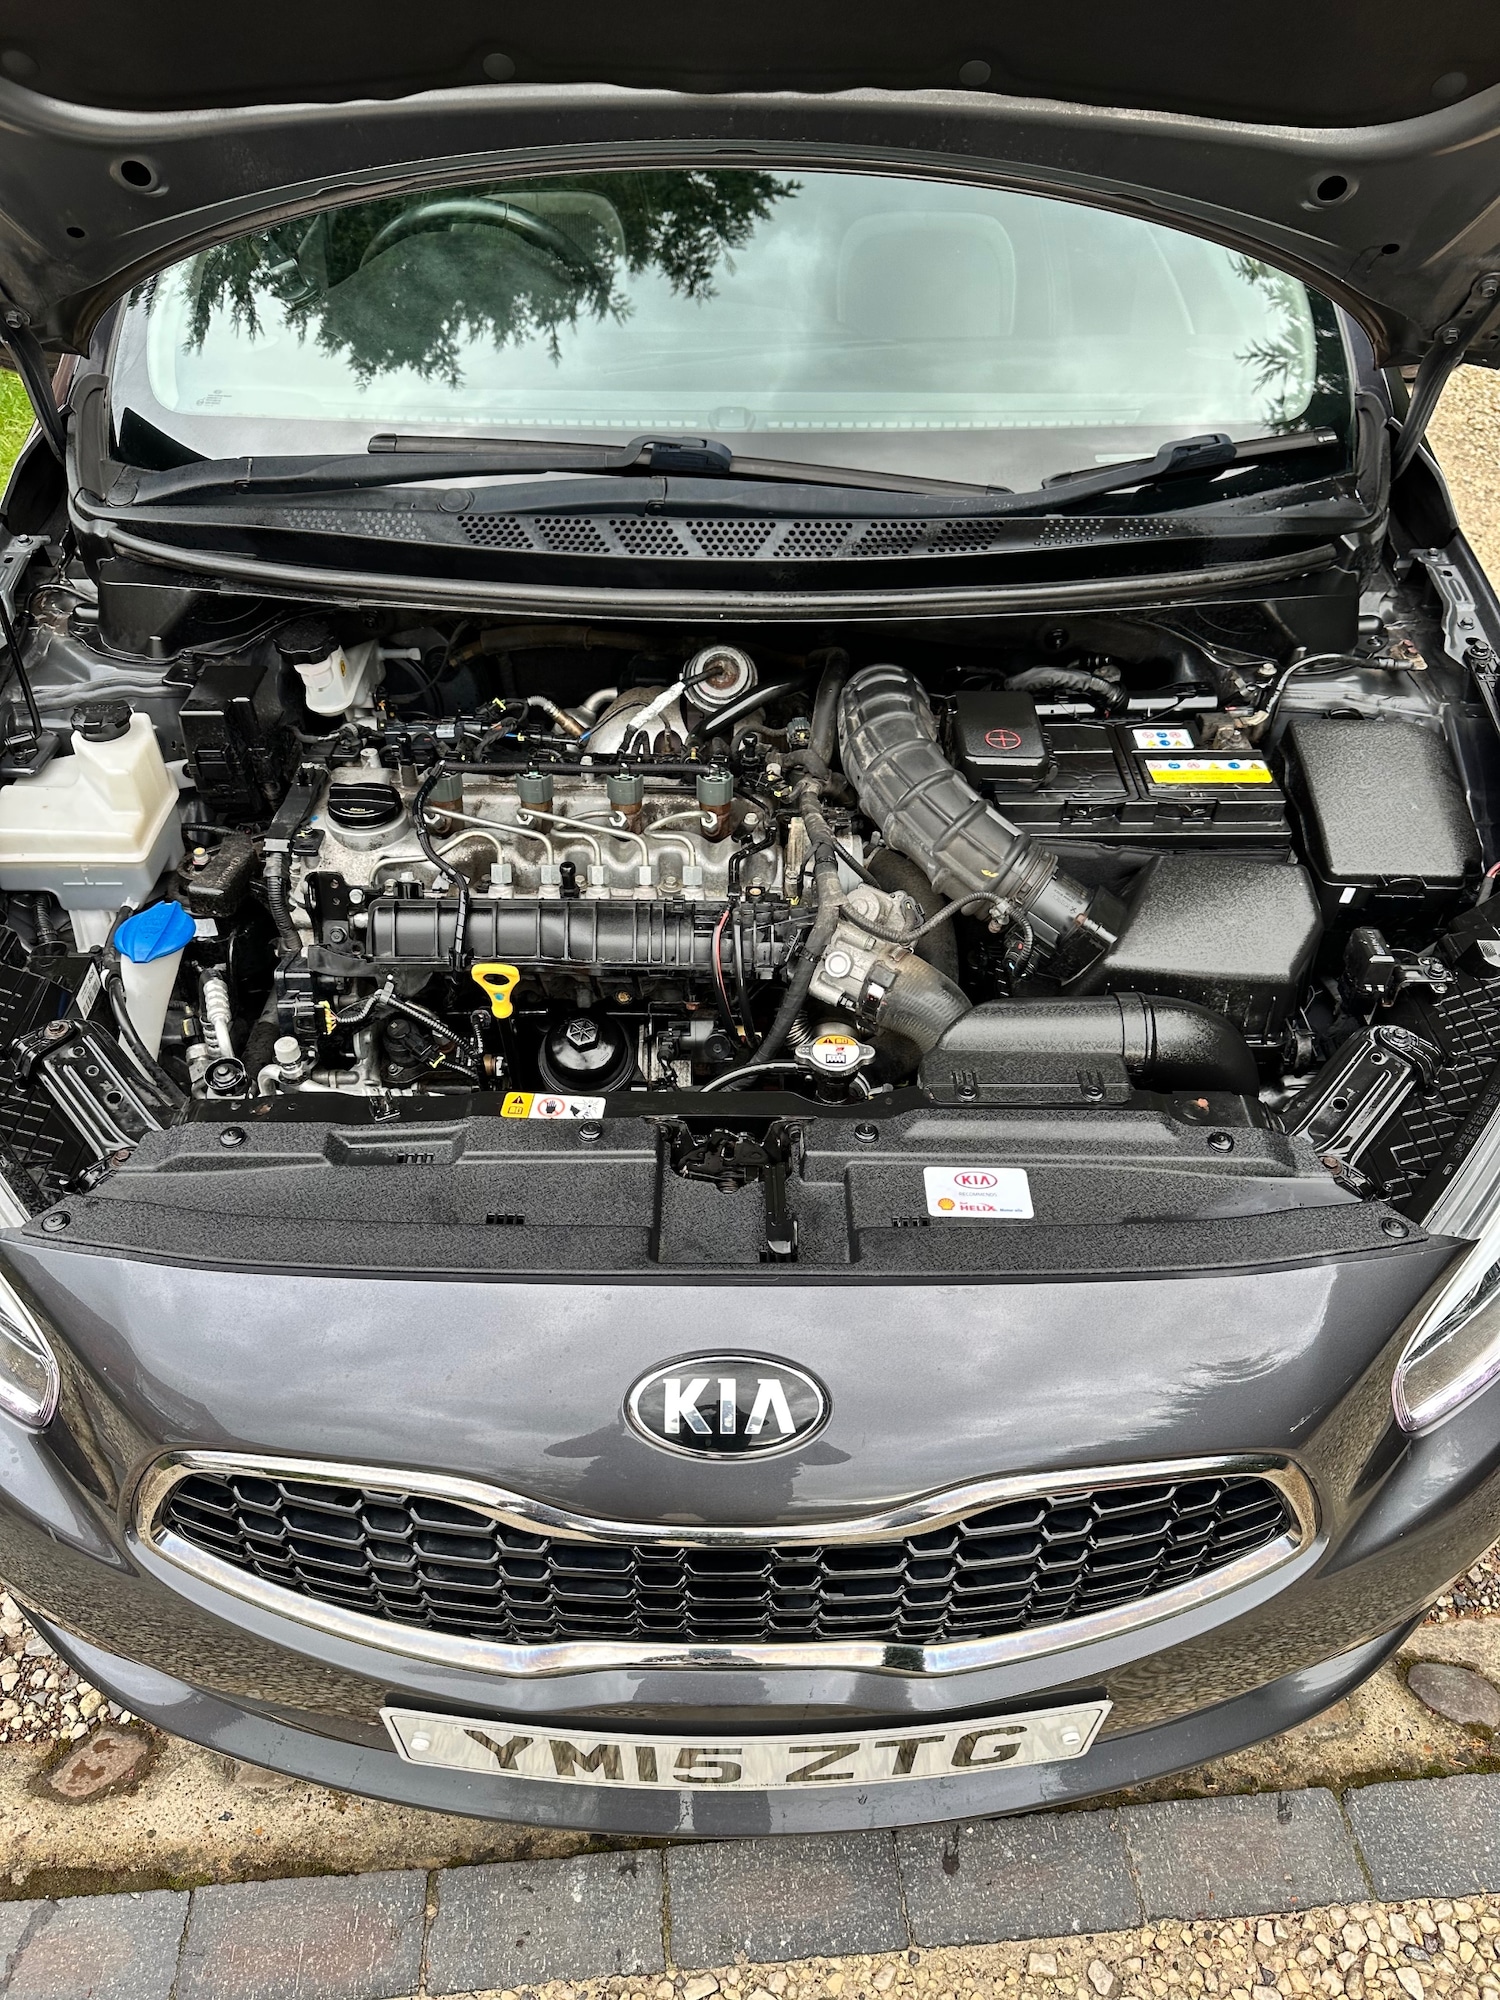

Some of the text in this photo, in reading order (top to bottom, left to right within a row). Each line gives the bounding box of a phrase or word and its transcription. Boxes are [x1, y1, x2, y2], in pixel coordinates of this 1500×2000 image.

[961, 1175, 991, 1186] KIA
[959, 1203, 998, 1212] HELIX
[662, 1378, 797, 1435] KIA
[463, 1725, 1028, 1783] YM15 ZTG
